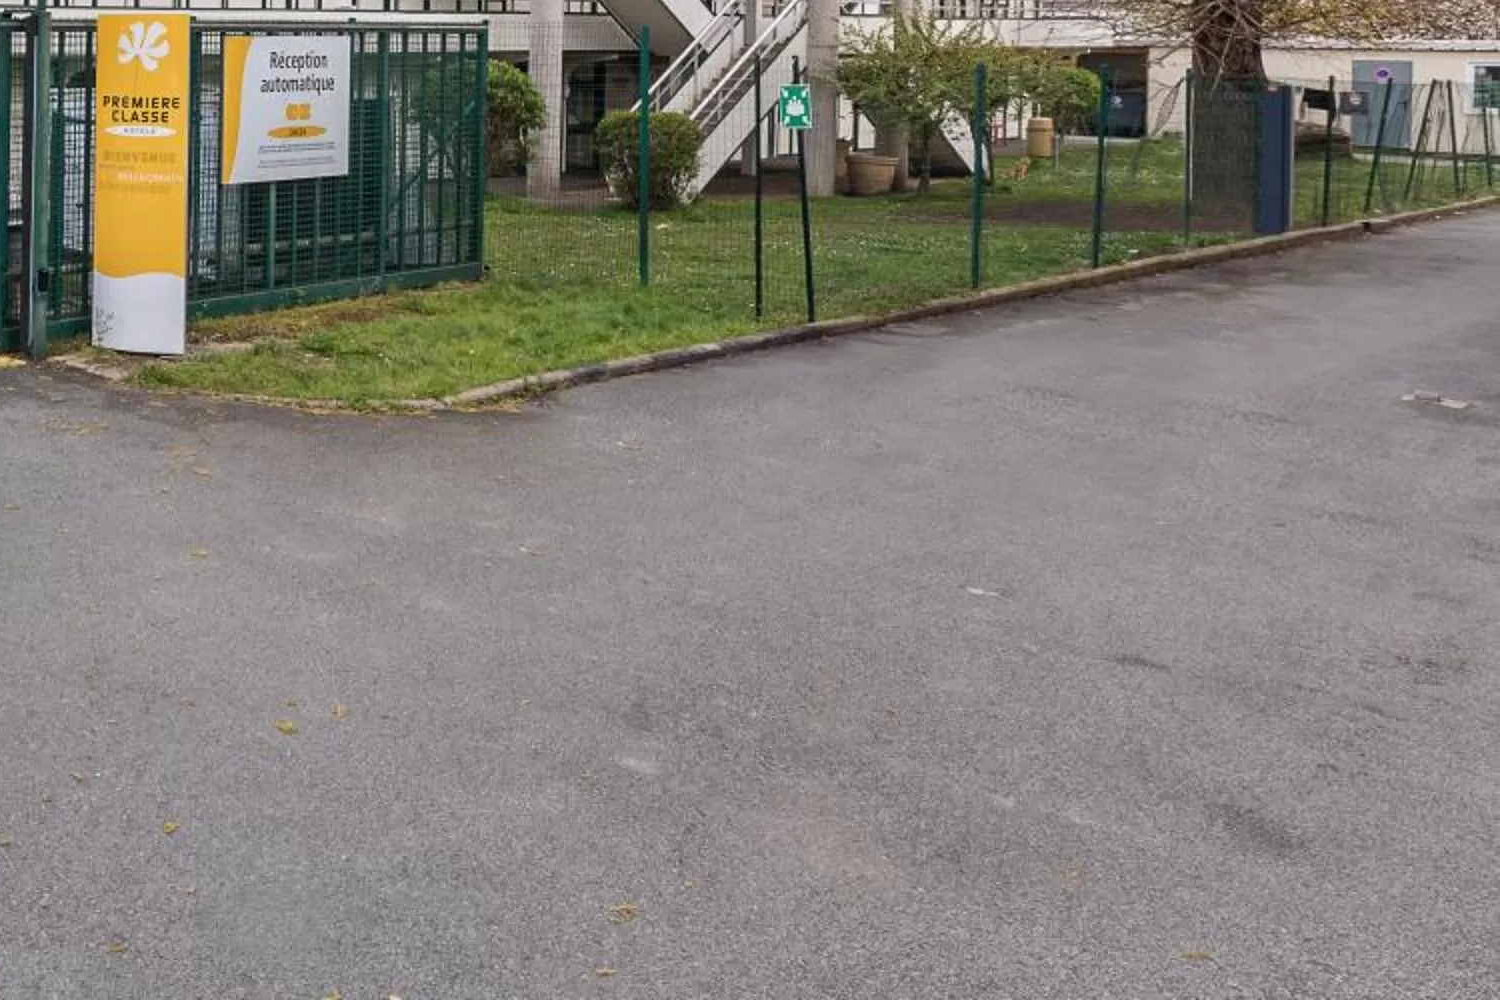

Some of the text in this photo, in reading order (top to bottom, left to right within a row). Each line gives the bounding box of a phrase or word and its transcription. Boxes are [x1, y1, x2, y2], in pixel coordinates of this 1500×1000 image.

[269, 49, 329, 73] Réception
[260, 74, 335, 96] automatique
[103, 95, 181, 109] PREMIERE
[111, 110, 169, 123] CLASSE
